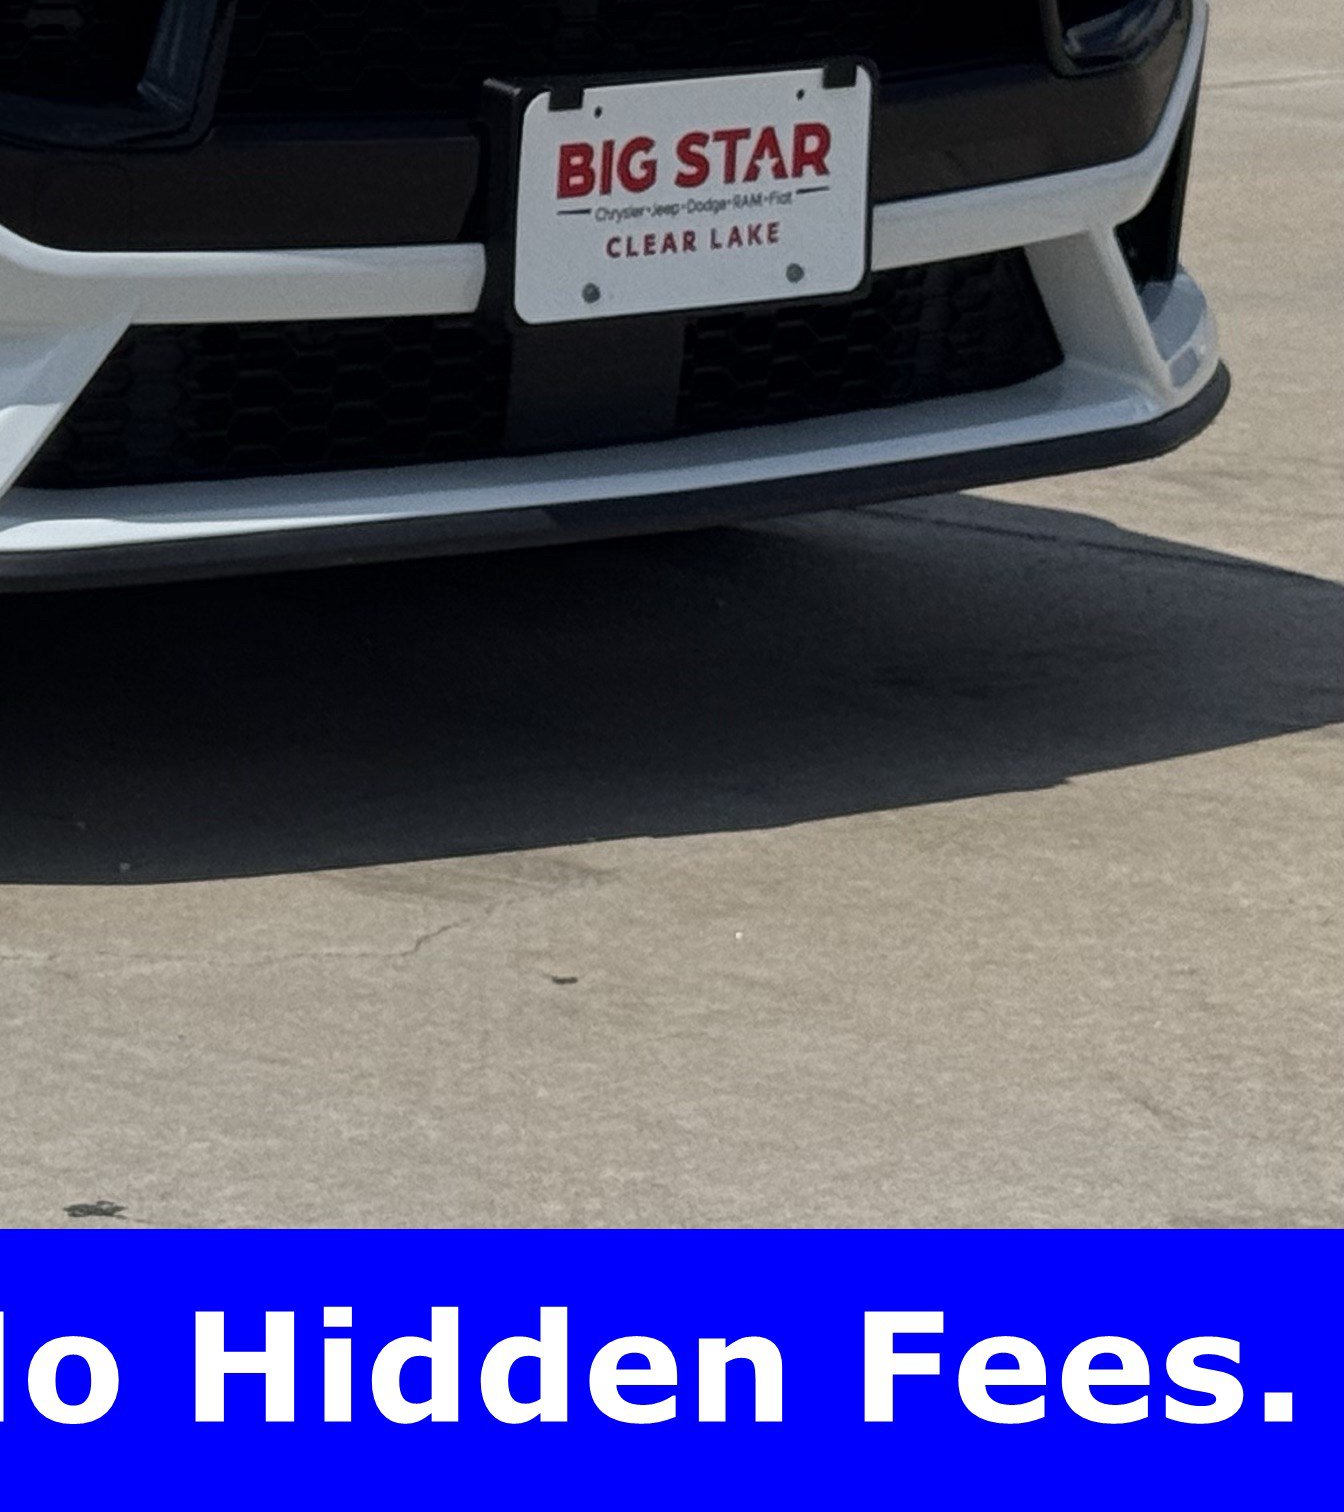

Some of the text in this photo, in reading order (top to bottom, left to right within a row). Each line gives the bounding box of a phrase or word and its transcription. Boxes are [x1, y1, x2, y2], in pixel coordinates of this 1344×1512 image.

[555, 121, 833, 199] BIG STAR
[605, 221, 781, 260] CLEAR LAKE
